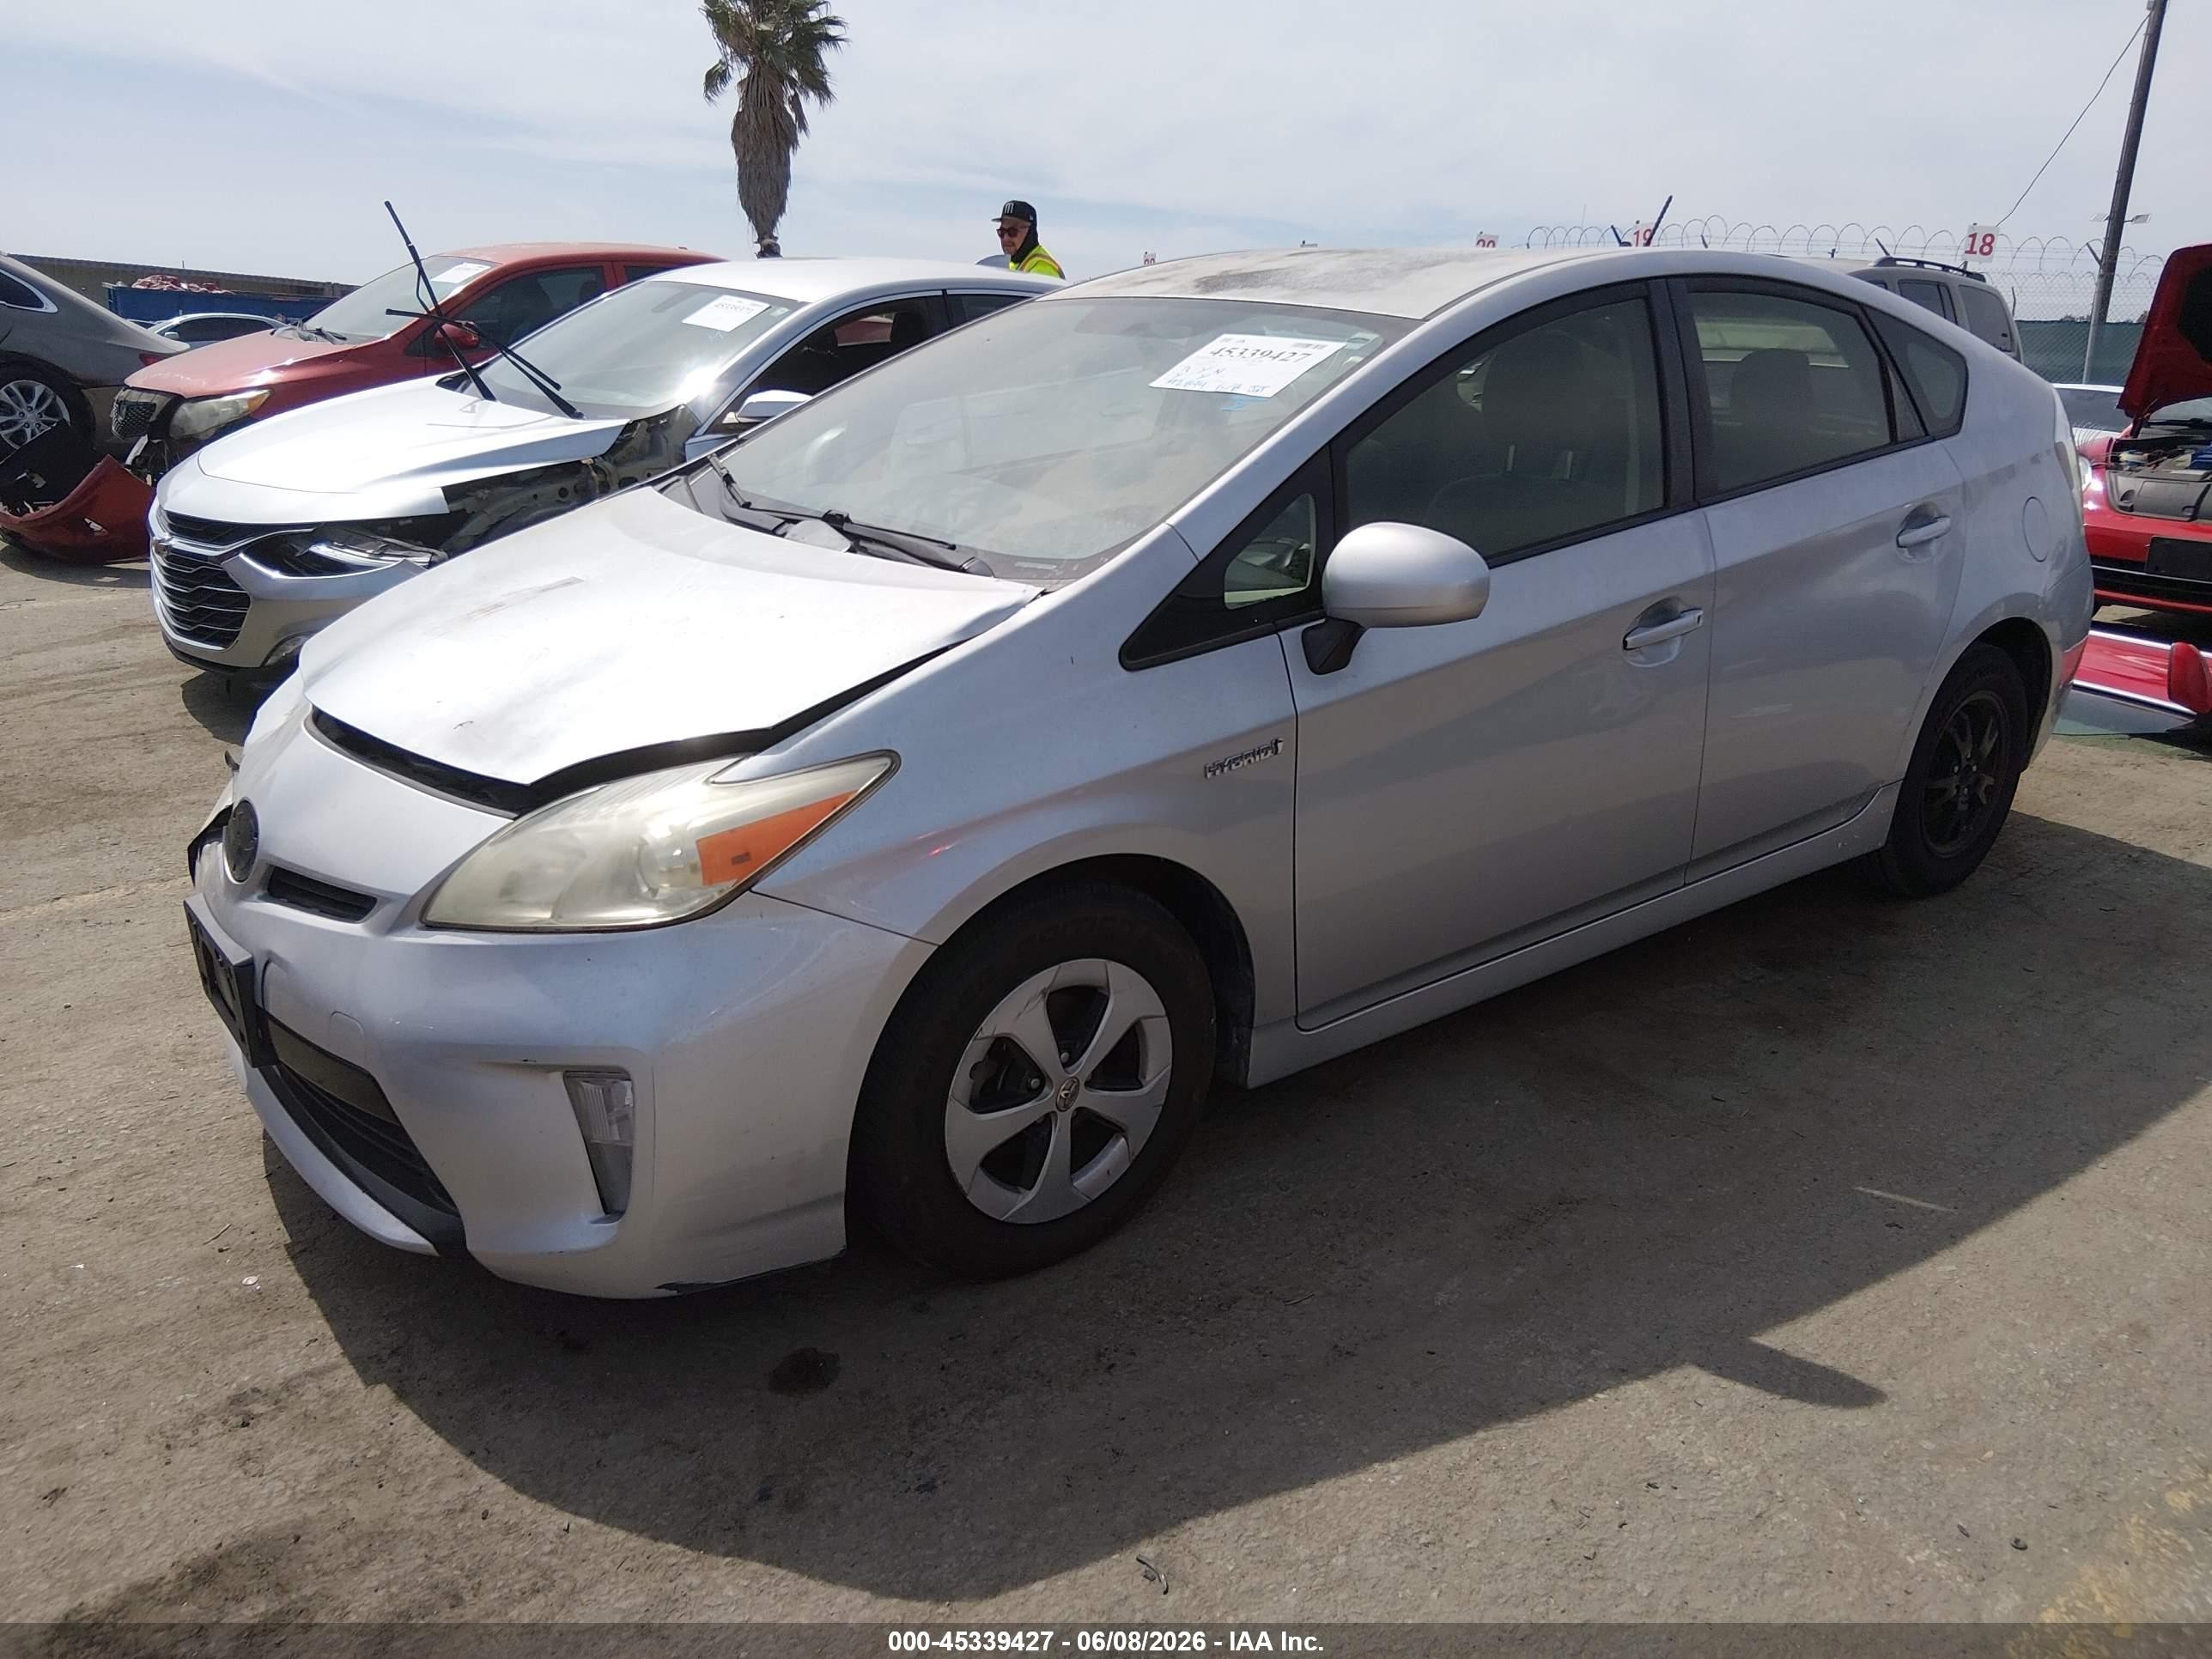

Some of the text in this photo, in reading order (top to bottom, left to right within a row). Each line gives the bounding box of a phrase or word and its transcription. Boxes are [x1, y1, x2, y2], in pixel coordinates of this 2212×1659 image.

[1633, 228, 1653, 247] 19
[1965, 232, 1996, 256] 18
[1208, 346, 1313, 364] 45339427
